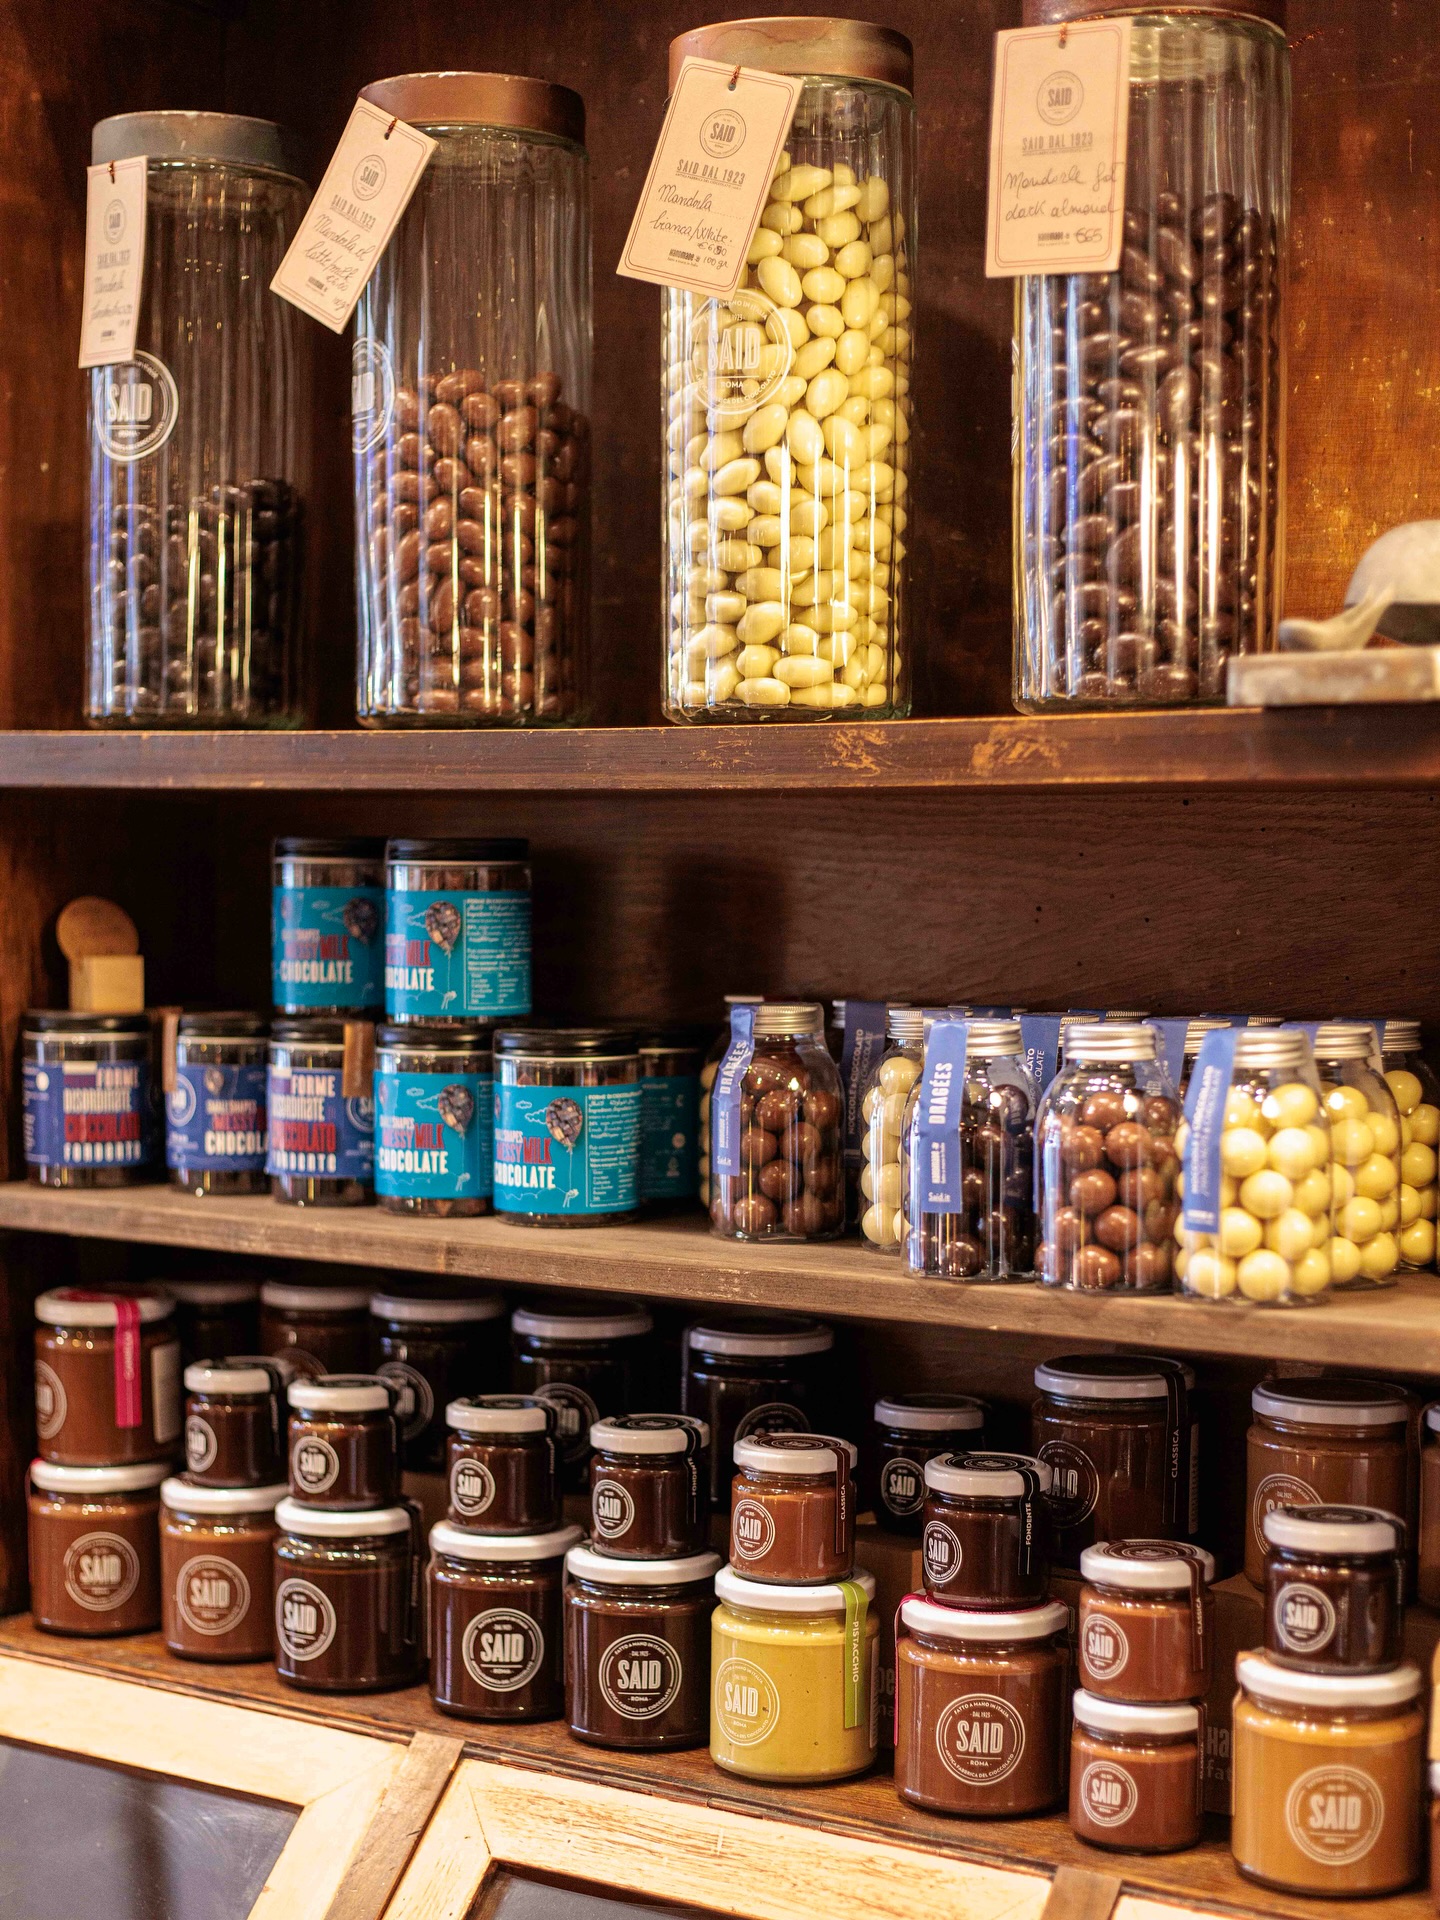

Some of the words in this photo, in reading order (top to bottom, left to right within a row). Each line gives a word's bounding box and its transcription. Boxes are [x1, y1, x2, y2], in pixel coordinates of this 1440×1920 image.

[1048, 87, 1072, 108] SAID
[710, 122, 736, 143] SAID
[1022, 135, 1044, 151] SAID
[1049, 133, 1065, 148] DAL
[360, 166, 379, 187] SAID
[677, 159, 699, 175] SAID
[702, 164, 719, 179] DAL
[723, 169, 746, 185] 1923
[708, 327, 761, 371] SAID
[106, 383, 153, 422] SAID
[320, 934, 349, 961] MILK
[280, 959, 353, 984] CHOCOLATE
[719, 1040, 748, 1094] DRAGÉES
[291, 1074, 336, 1098] FORME
[928, 1062, 953, 1125] DRAGÉES
[414, 1123, 445, 1150] MILK
[523, 1136, 553, 1165] MILK
[379, 1147, 449, 1175] CHOCOLATE
[494, 1161, 556, 1190] CHOCOLATE
[1171, 1429, 1180, 1478] CLASSICA
[889, 1473, 916, 1497] SAID
[598, 1495, 622, 1520] SAID
[739, 1515, 762, 1541] SAID
[928, 1537, 949, 1563] SAID
[284, 1600, 317, 1635] SAID
[1286, 1601, 1319, 1630] SAID
[480, 1632, 525, 1663] SAID
[1088, 1631, 1114, 1659] SAID
[617, 1659, 662, 1690] SAID
[724, 1681, 759, 1717] SAID
[954, 1703, 969, 1715] FATTO
[956, 1720, 1004, 1754] SAID
[988, 1753, 1015, 1777] CIOCCOLATO
[1091, 1778, 1122, 1806] SAID
[1308, 1793, 1362, 1831] SAID
